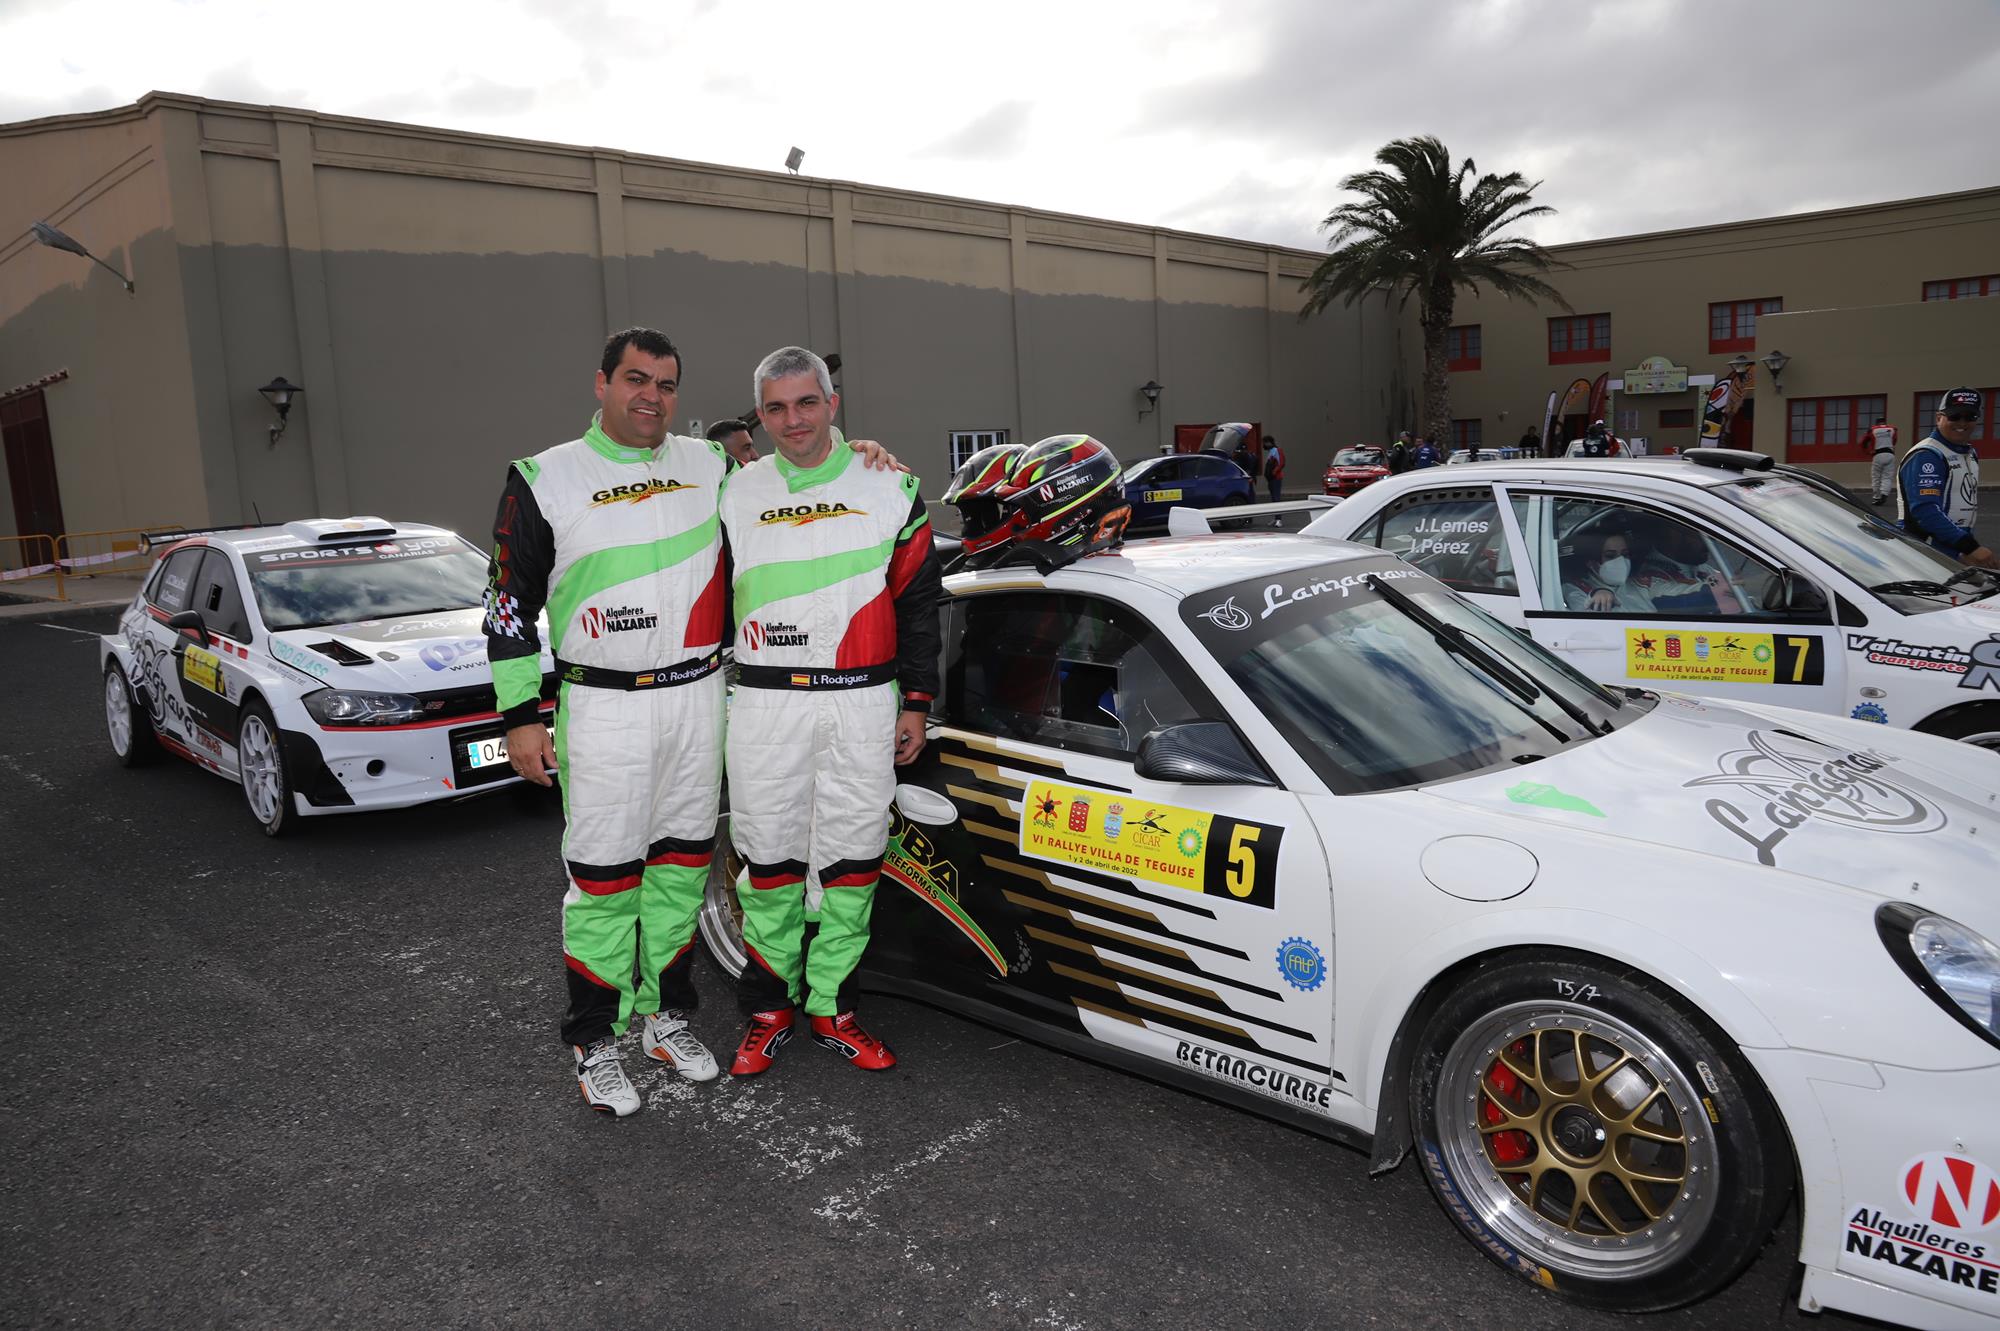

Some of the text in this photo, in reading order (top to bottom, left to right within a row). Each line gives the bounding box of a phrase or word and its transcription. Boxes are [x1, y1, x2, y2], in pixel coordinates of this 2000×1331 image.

[1640, 438, 1646, 448] 1
[592, 479, 682, 502] GROBA
[1056, 475, 1090, 493] NAZARET
[760, 503, 848, 522] GROBA
[1415, 518, 1489, 533] J.Lemes
[259, 546, 374, 563] SPORTS
[379, 549, 436, 560] CANARIAS
[1411, 537, 1470, 554] I.Pérez
[605, 606, 644, 619] Alquileres
[606, 616, 658, 633] NAZARET
[765, 622, 797, 632] Alquileres
[766, 634, 809, 647] NAZARET
[1848, 634, 1971, 663] Valentin
[292, 652, 328, 678] GLASS
[1788, 637, 1810, 682] 7
[1635, 664, 1645, 672] VI
[1648, 664, 1683, 673] RALLYE
[1684, 666, 1712, 674] VILLA
[1730, 668, 1768, 676] TEGUISE
[1132, 831, 1161, 848] CICAR
[1033, 834, 1043, 845] VI
[1047, 837, 1088, 855] RALLYE
[1090, 846, 1123, 863] VILLA
[1125, 854, 1140, 866] DE
[1145, 858, 1195, 879] TEGUISE
[1225, 823, 1261, 898] 5
[888, 850, 939, 900] REFORMAS
[1094, 860, 1110, 870] abril
[1111, 864, 1120, 872] de
[1121, 866, 1138, 876] 2022
[1176, 1041, 1332, 1109] BETANCURBE
[1178, 1059, 1330, 1115] TALLER DE ELECTRICIDAD DEL AUTOMÓVIL
[1426, 1151, 1512, 1261] MICHELIN
[1850, 1208, 1986, 1258] Alquileres
